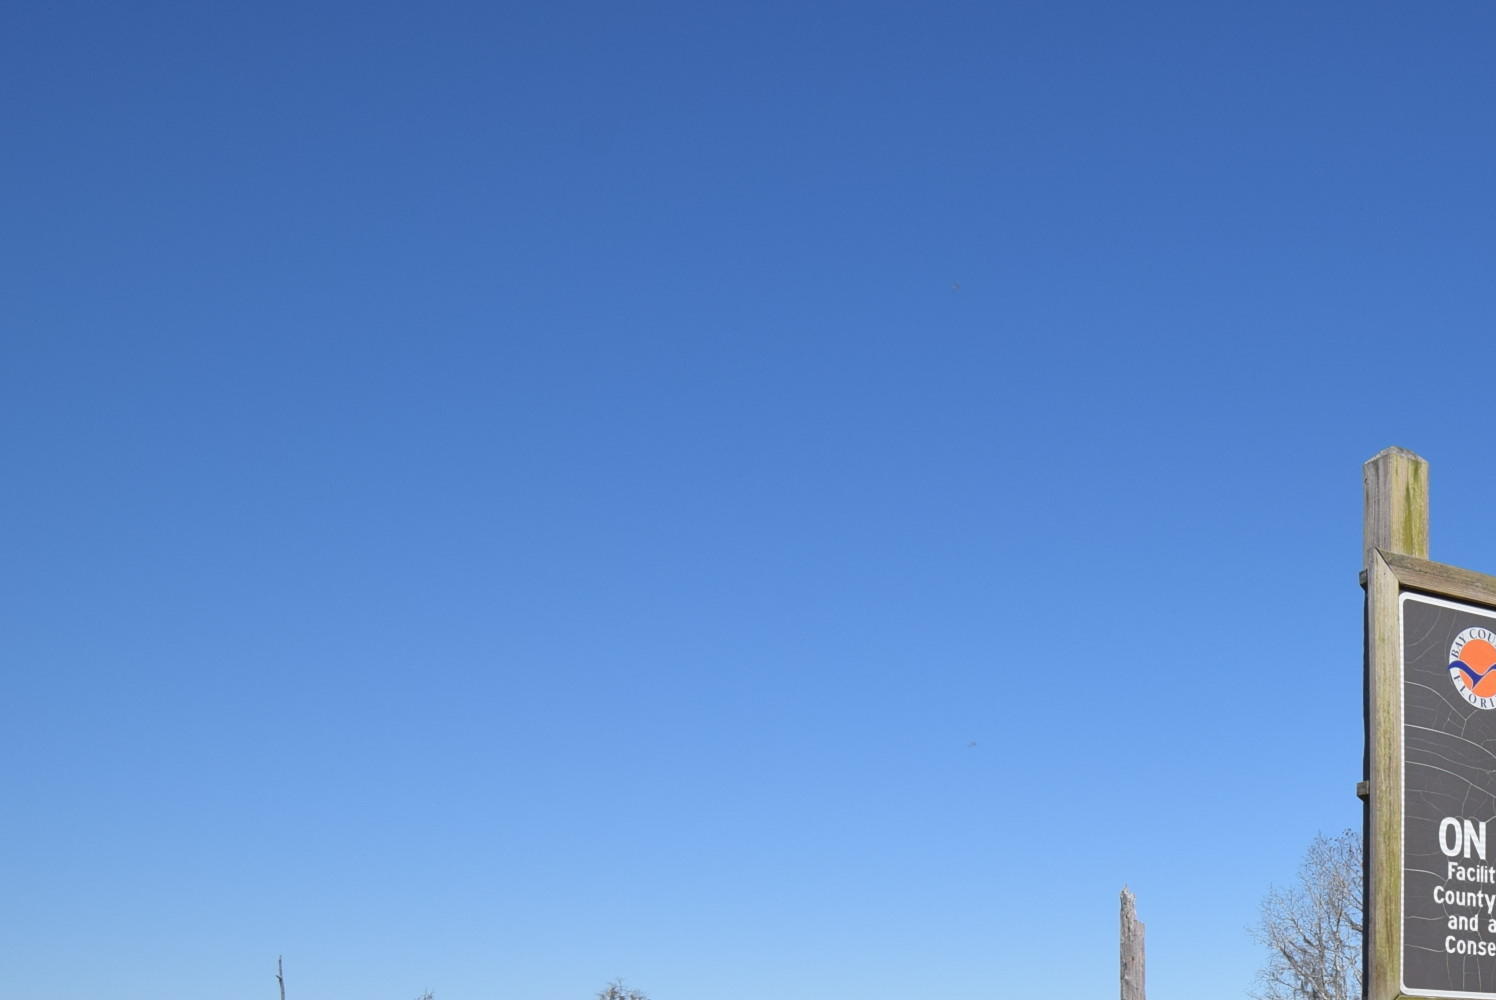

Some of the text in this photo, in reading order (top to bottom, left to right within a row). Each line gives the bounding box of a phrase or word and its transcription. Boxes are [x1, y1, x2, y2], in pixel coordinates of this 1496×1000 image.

[1451, 636, 1466, 658] BAY
[1438, 817, 1486, 860] ON
[1433, 885, 1496, 914] County
[1447, 914, 1479, 931] and
